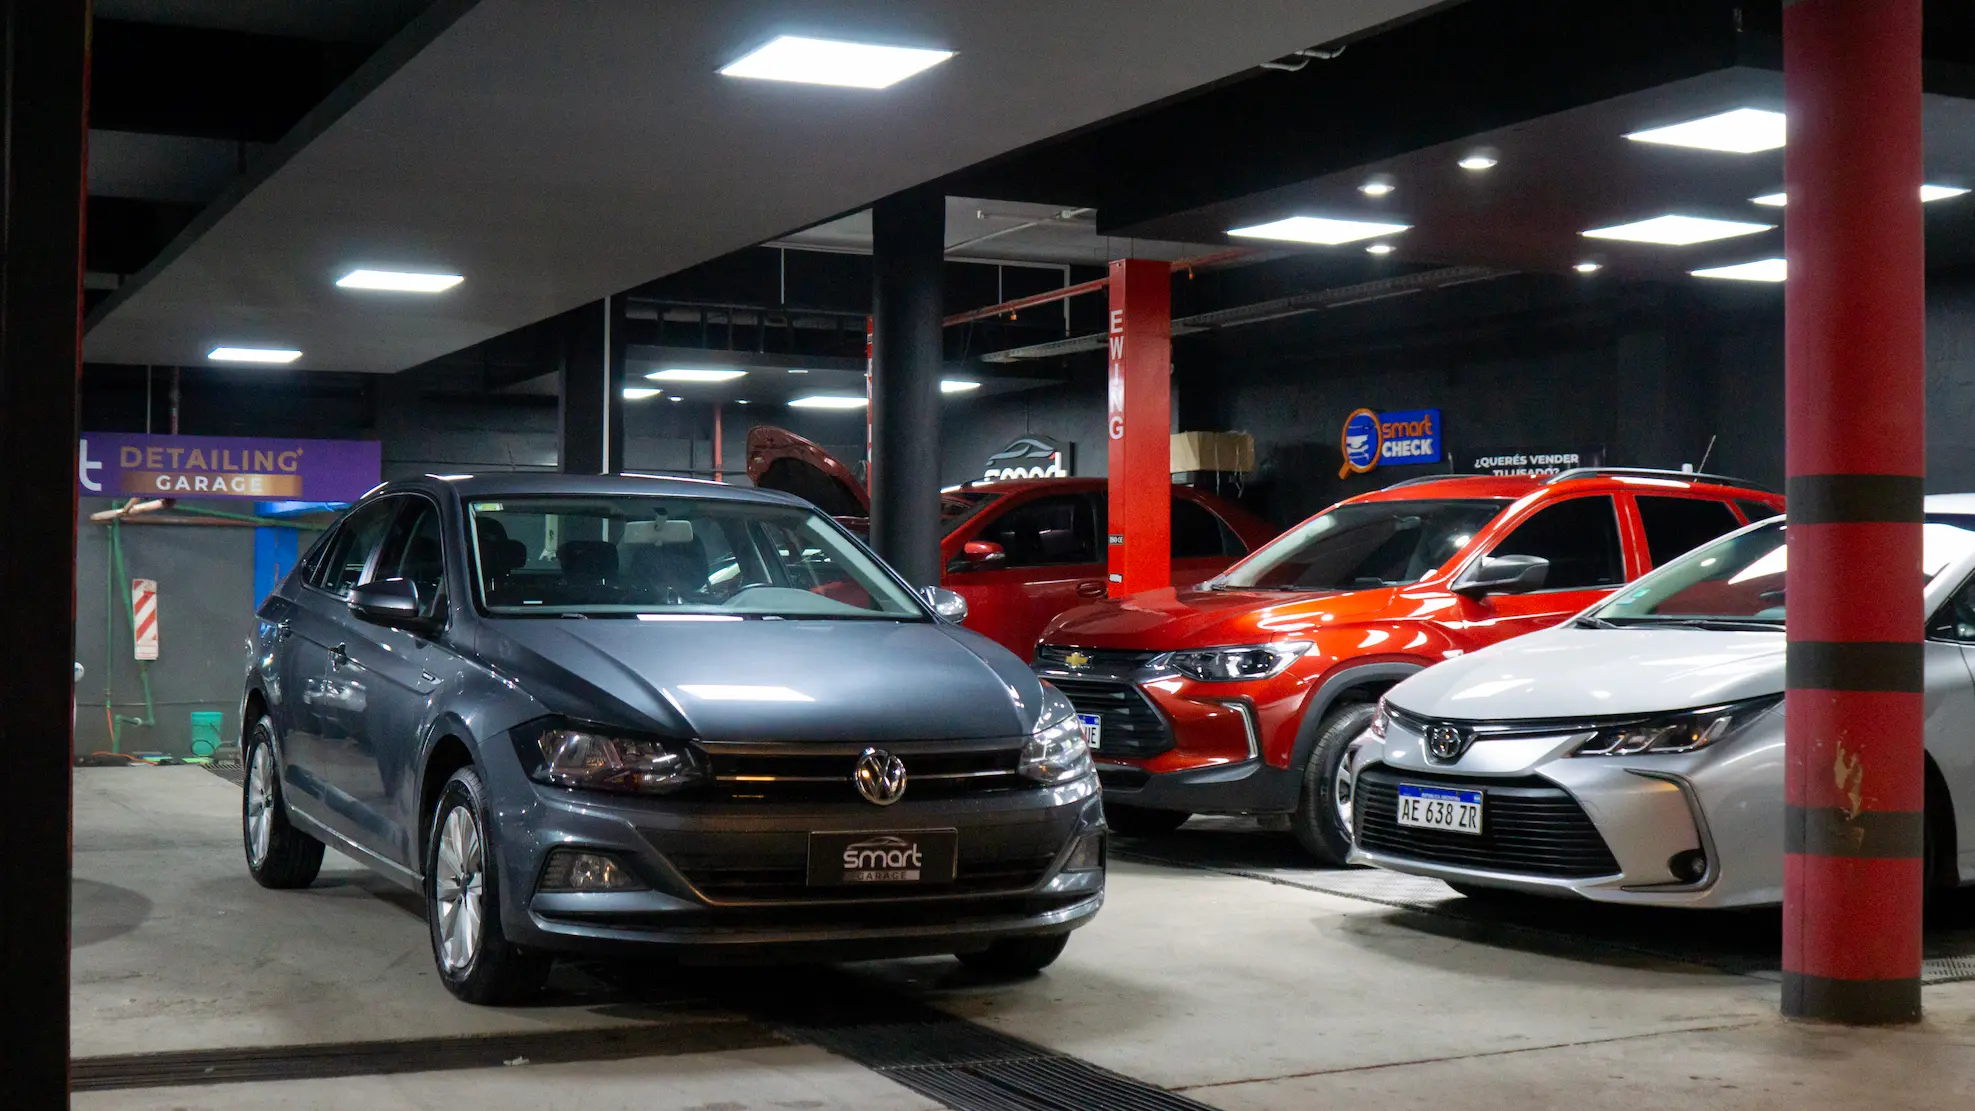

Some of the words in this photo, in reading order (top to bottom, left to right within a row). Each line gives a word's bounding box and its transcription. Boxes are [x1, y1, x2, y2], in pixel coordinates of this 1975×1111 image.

[1109, 309, 1124, 440] EWING
[1381, 414, 1433, 438] smart
[119, 446, 298, 472] DETAILING
[1382, 438, 1433, 458] CHECK
[1474, 454, 1527, 469] ¿QUERÉS
[1529, 454, 1579, 465] VENDER
[155, 474, 264, 493] GARAGE
[1401, 798, 1421, 822] AE
[1425, 801, 1454, 826] 638
[1459, 804, 1477, 829] ZR
[843, 843, 923, 869] smart
[856, 870, 908, 880] GARAGE
